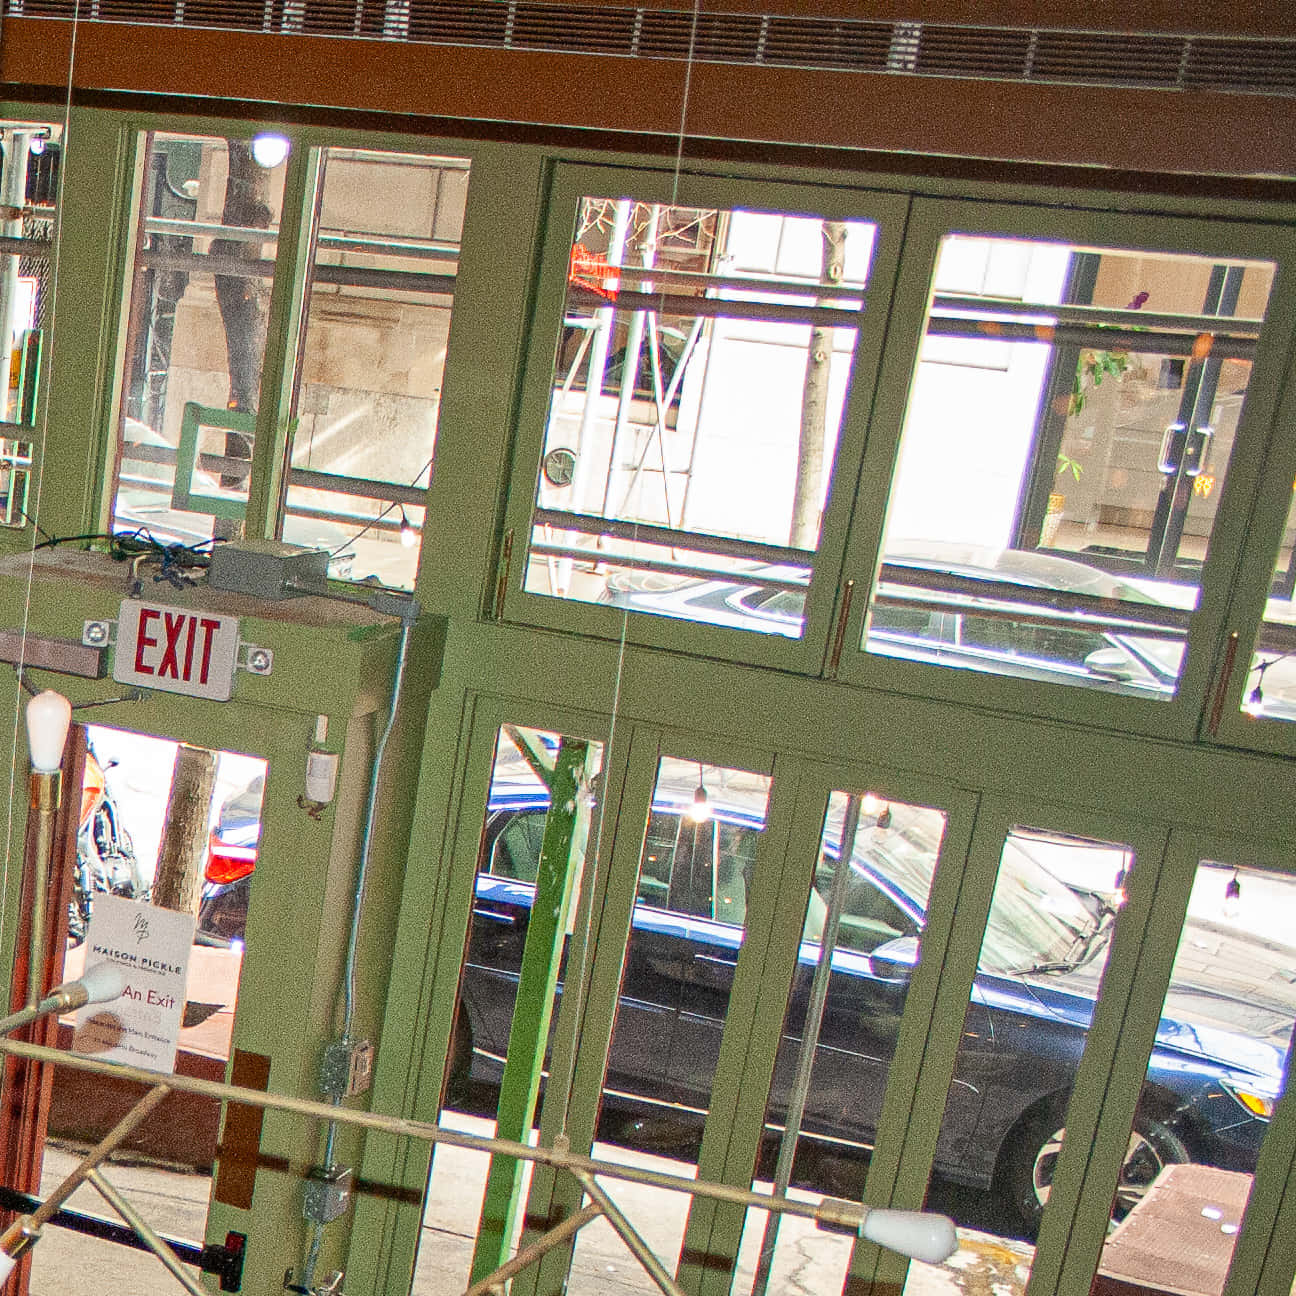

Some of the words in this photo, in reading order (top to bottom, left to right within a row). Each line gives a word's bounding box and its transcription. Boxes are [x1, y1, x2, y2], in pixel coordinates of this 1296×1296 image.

[135, 608, 221, 684] EXIT
[93, 944, 137, 962] MAISON
[142, 957, 183, 975] PICKLE
[122, 985, 142, 1001] An
[147, 989, 176, 1009] Exit
